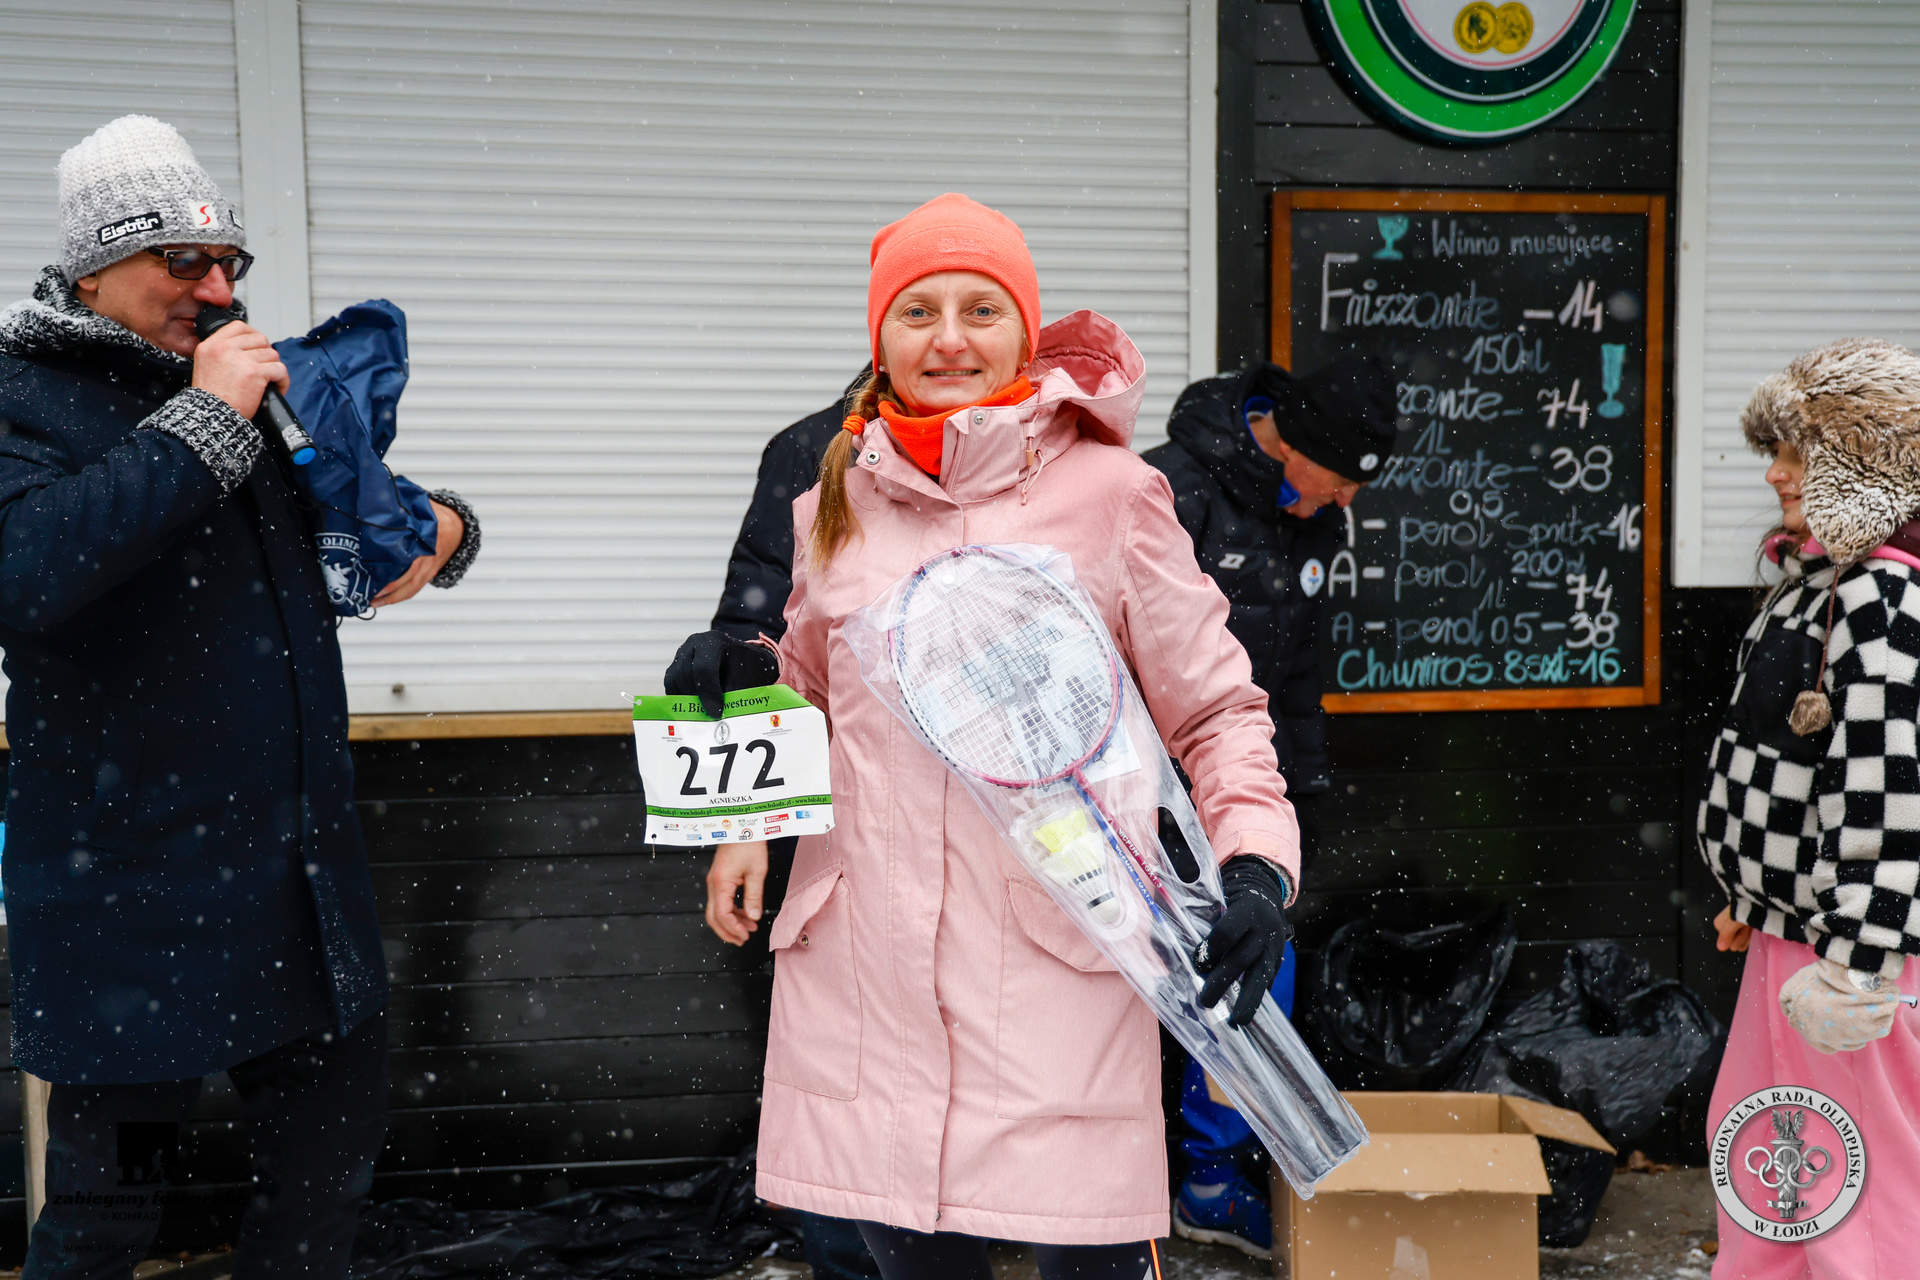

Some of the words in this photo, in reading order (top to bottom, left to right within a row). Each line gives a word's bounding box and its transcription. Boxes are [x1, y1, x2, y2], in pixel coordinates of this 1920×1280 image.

[101, 216, 159, 243] Eisbär
[1432, 219, 1500, 258] Winno
[1547, 445, 1614, 493] 38
[1449, 488, 1504, 520] 0,5
[322, 536, 360, 550] OLIMP
[1336, 646, 1494, 690] Churros
[688, 702, 705, 713] Bie
[675, 738, 785, 796] 272
[709, 794, 753, 806] AGNIESZKA
